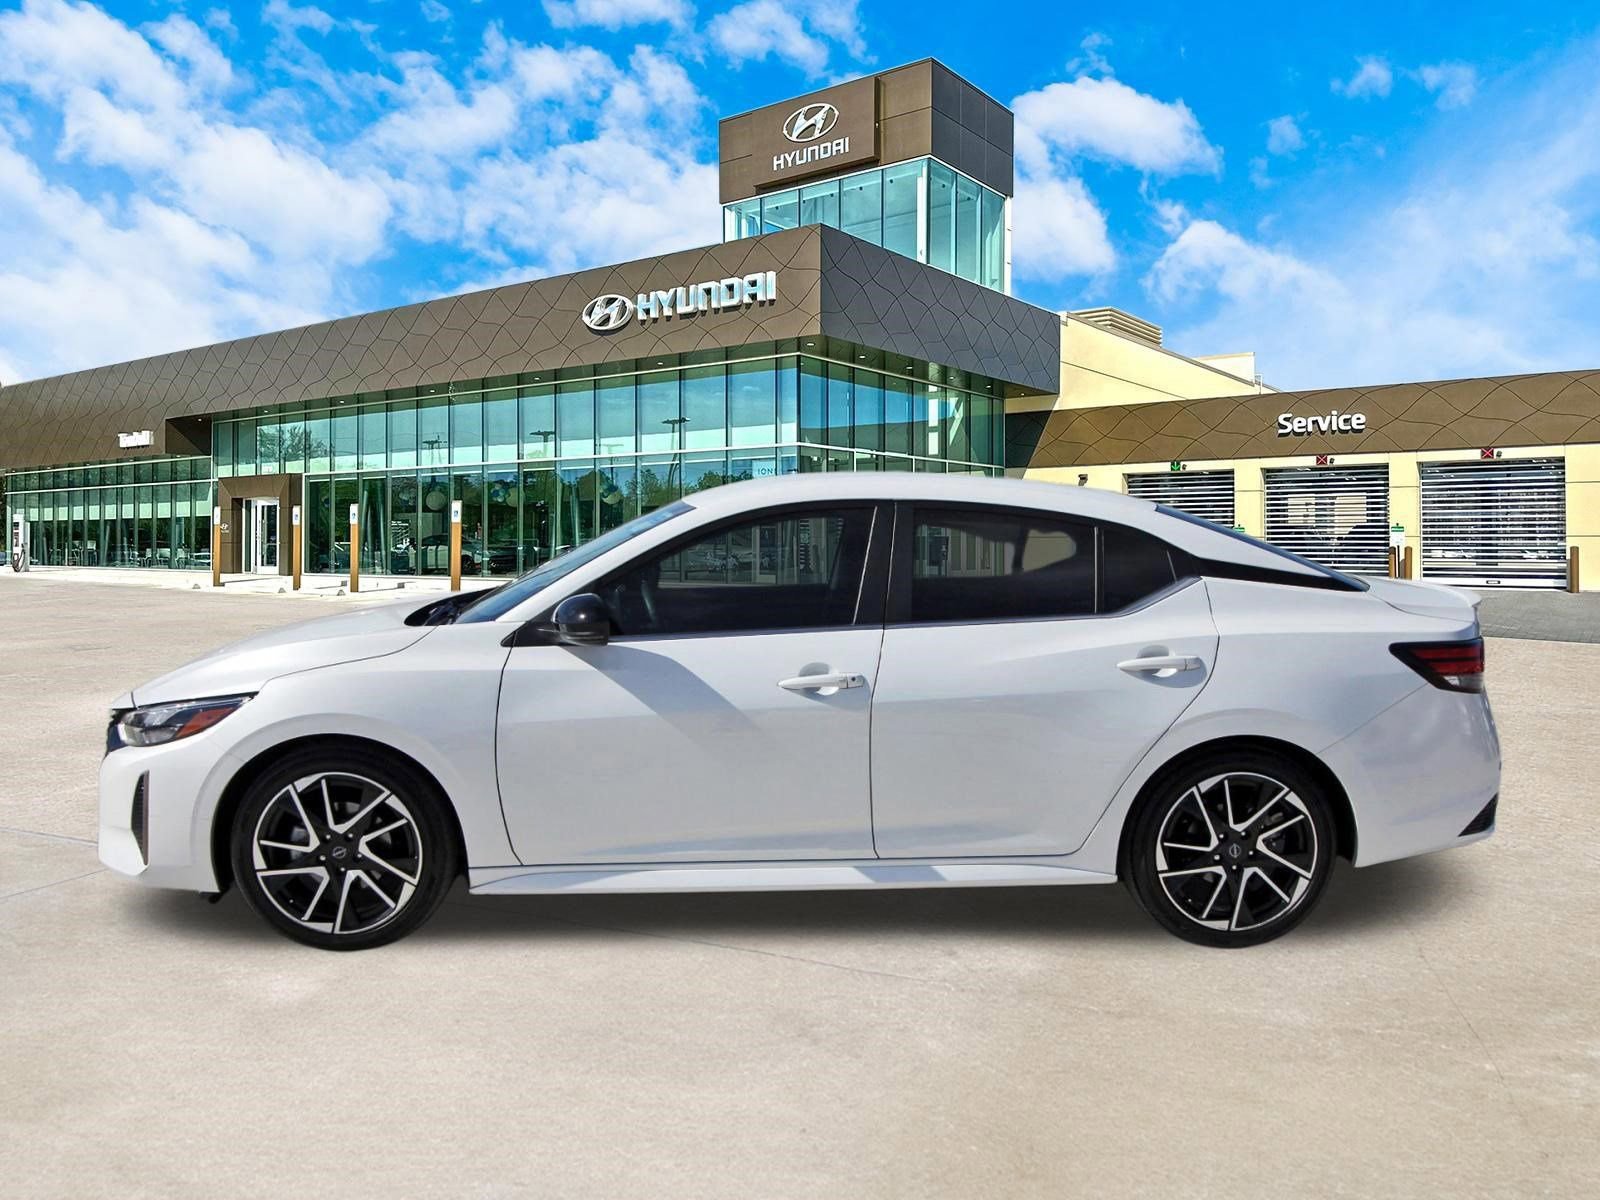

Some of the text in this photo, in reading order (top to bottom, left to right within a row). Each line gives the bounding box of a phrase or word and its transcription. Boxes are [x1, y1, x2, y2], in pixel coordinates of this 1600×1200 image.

[773, 136, 849, 171] HYUNDAI
[636, 271, 776, 321] HYUNDAI
[1277, 410, 1366, 434] Service
